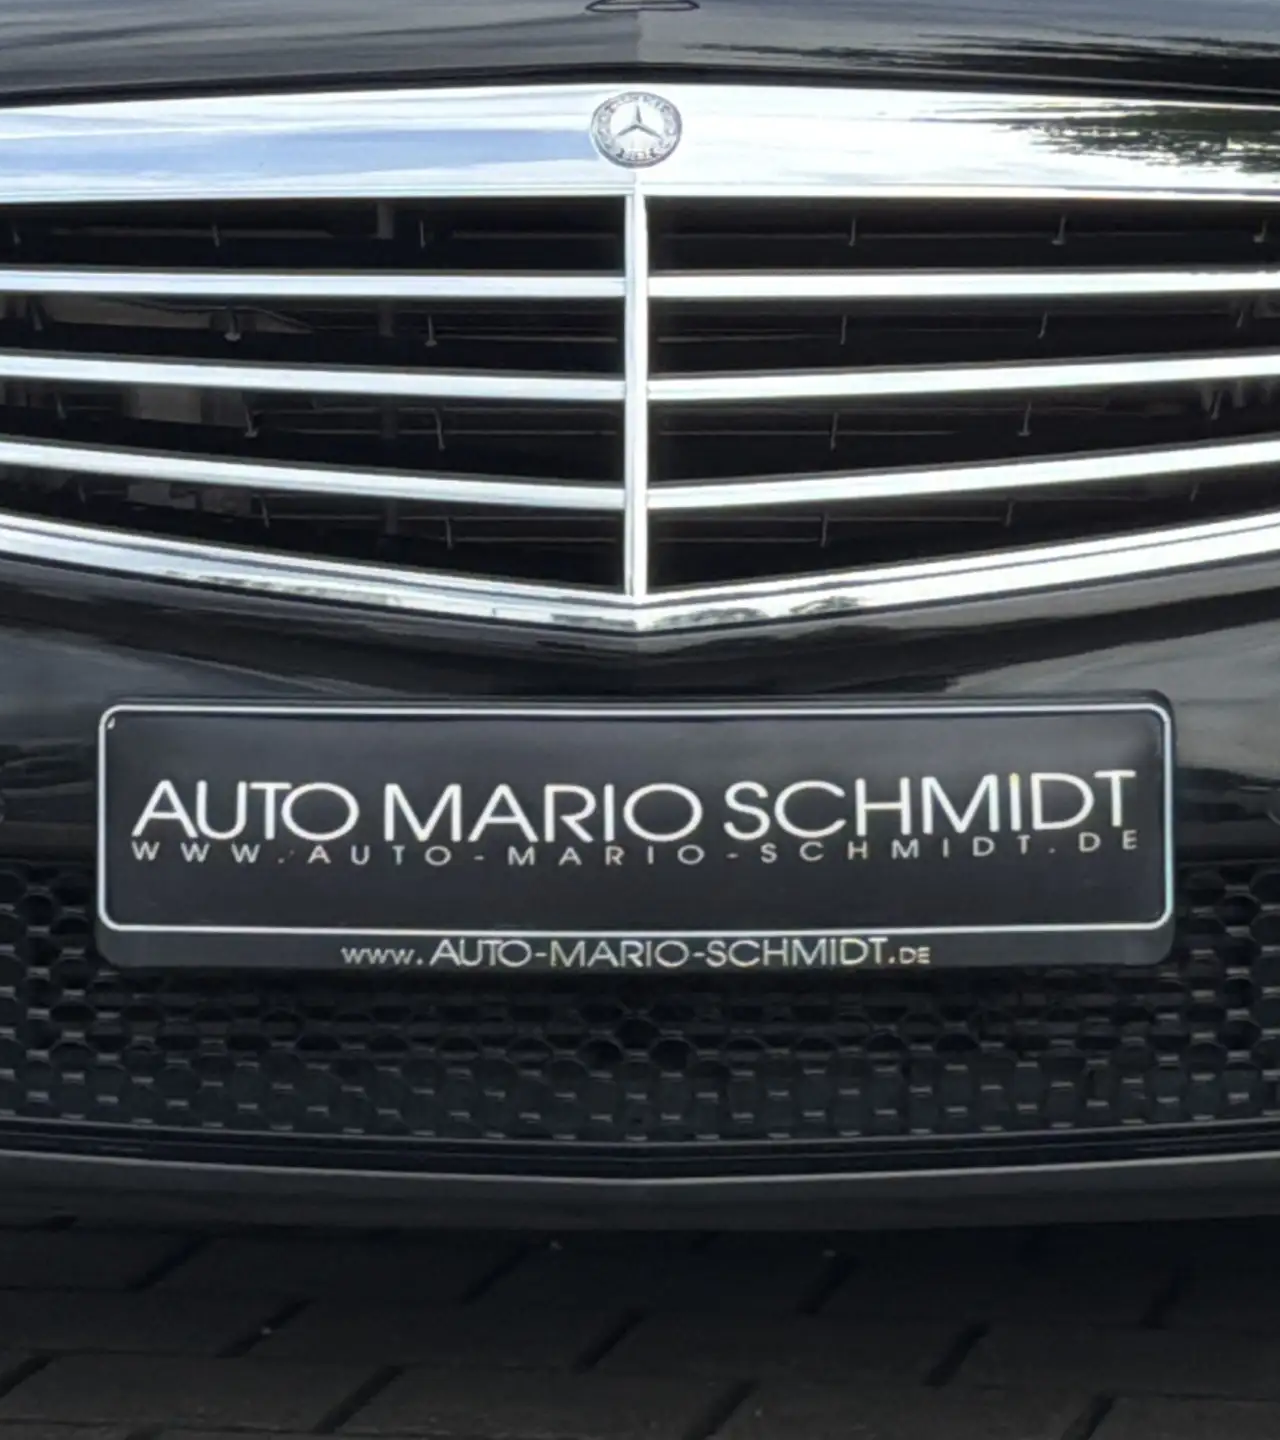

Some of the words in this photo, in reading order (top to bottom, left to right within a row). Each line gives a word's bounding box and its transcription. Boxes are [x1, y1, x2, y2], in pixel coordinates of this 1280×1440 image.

[131, 779, 360, 842] AUTO
[383, 781, 704, 844] MARIO
[723, 768, 1137, 842] SCHMIDT
[131, 829, 1138, 866] WWW.AUTO-MARIO-SCHMIDT.DE
